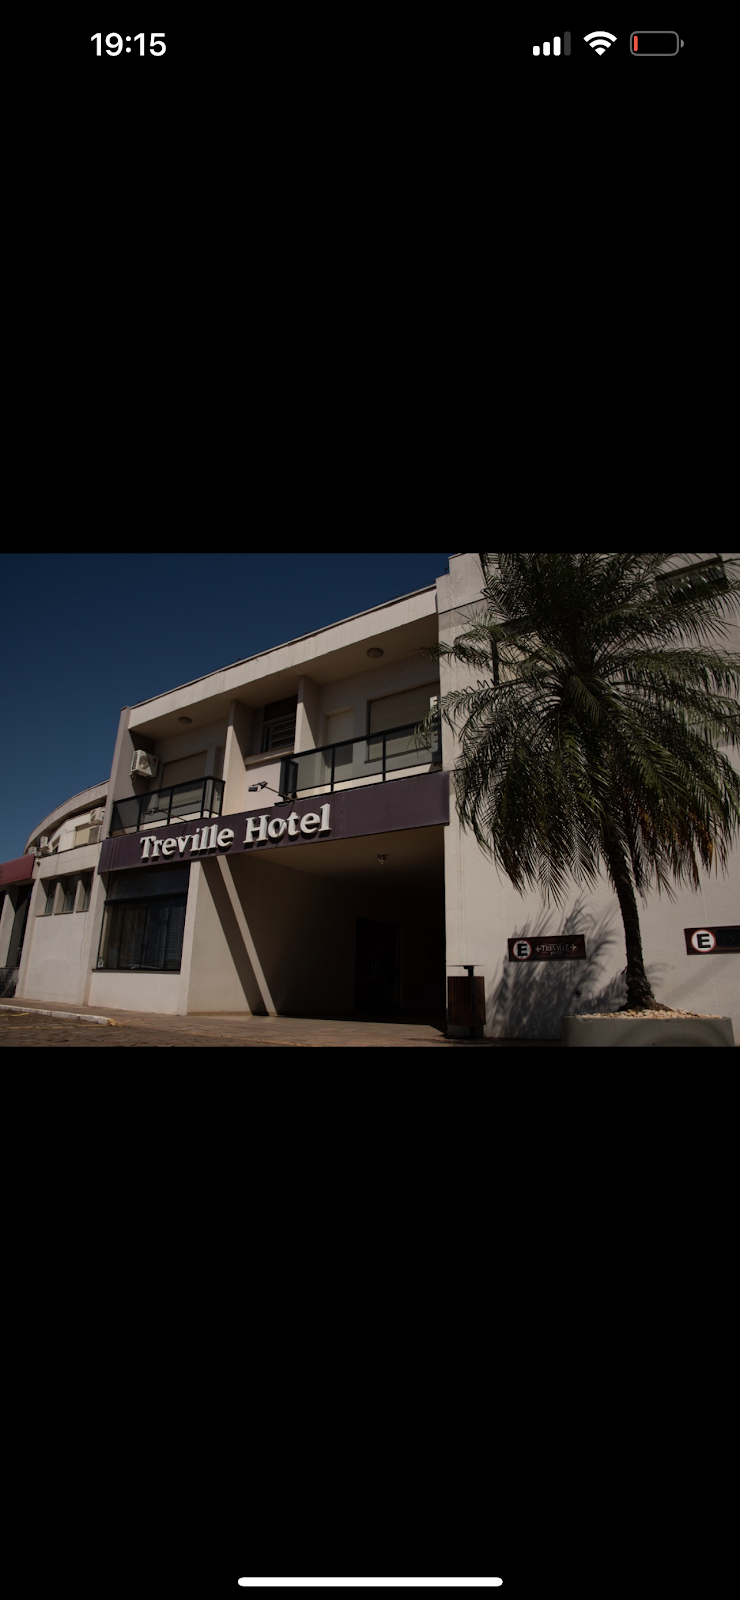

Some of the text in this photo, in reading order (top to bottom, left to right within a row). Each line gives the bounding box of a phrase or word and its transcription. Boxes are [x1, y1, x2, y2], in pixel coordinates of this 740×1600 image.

[140, 803, 331, 859] Treville Hotel
[696, 934, 711, 948] E
[517, 943, 570, 956] E TREVILLE
